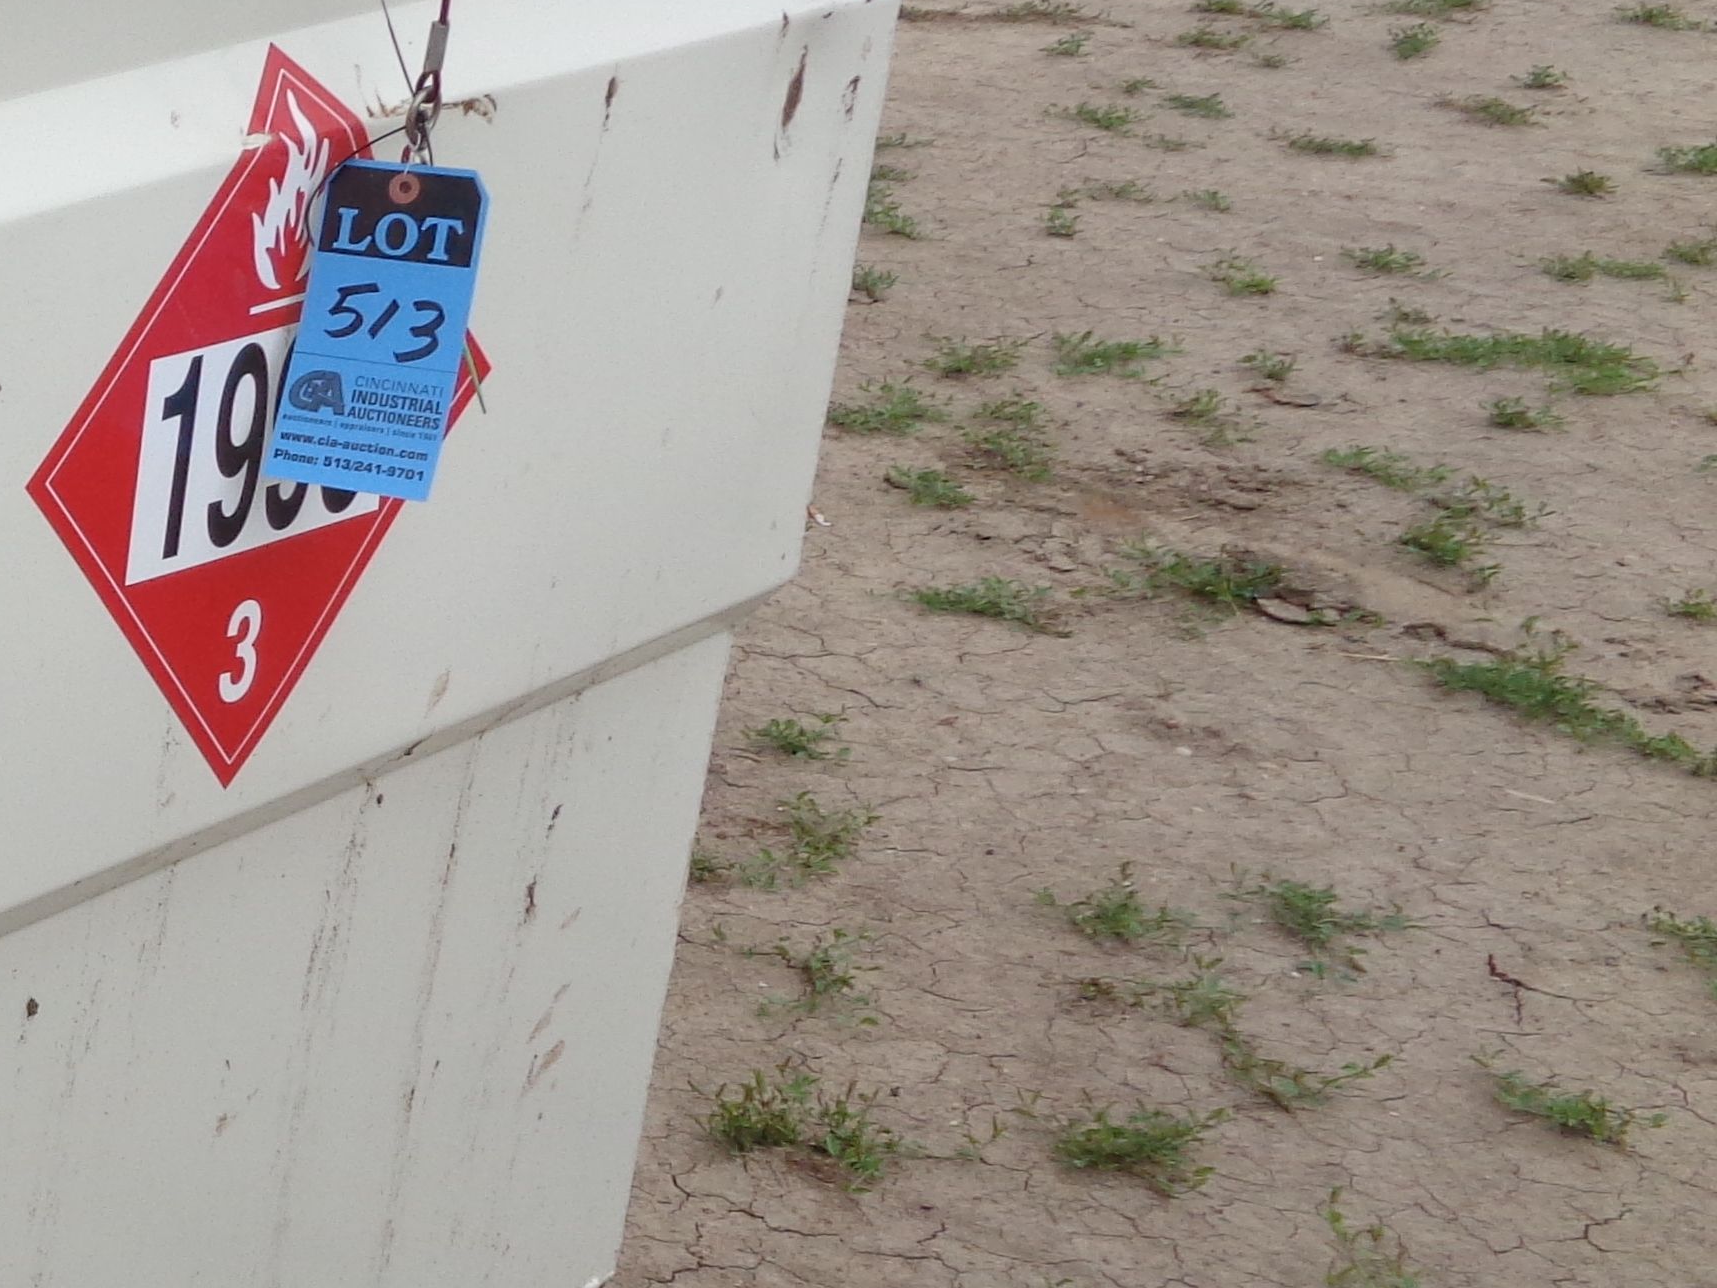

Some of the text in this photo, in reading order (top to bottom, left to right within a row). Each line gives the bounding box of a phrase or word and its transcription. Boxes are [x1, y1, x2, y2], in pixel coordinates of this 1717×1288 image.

[332, 207, 464, 261] LOT
[323, 282, 446, 363] 513
[351, 389, 443, 415] INDUSTRIAL
[354, 375, 445, 398] CINCINNATI
[348, 406, 441, 431] AUCTIONEERS
[161, 338, 362, 560] 19
[280, 430, 429, 462] www.cia-auction.com
[273, 447, 425, 482] Phone: 513/241-9701
[218, 598, 263, 705] 3
